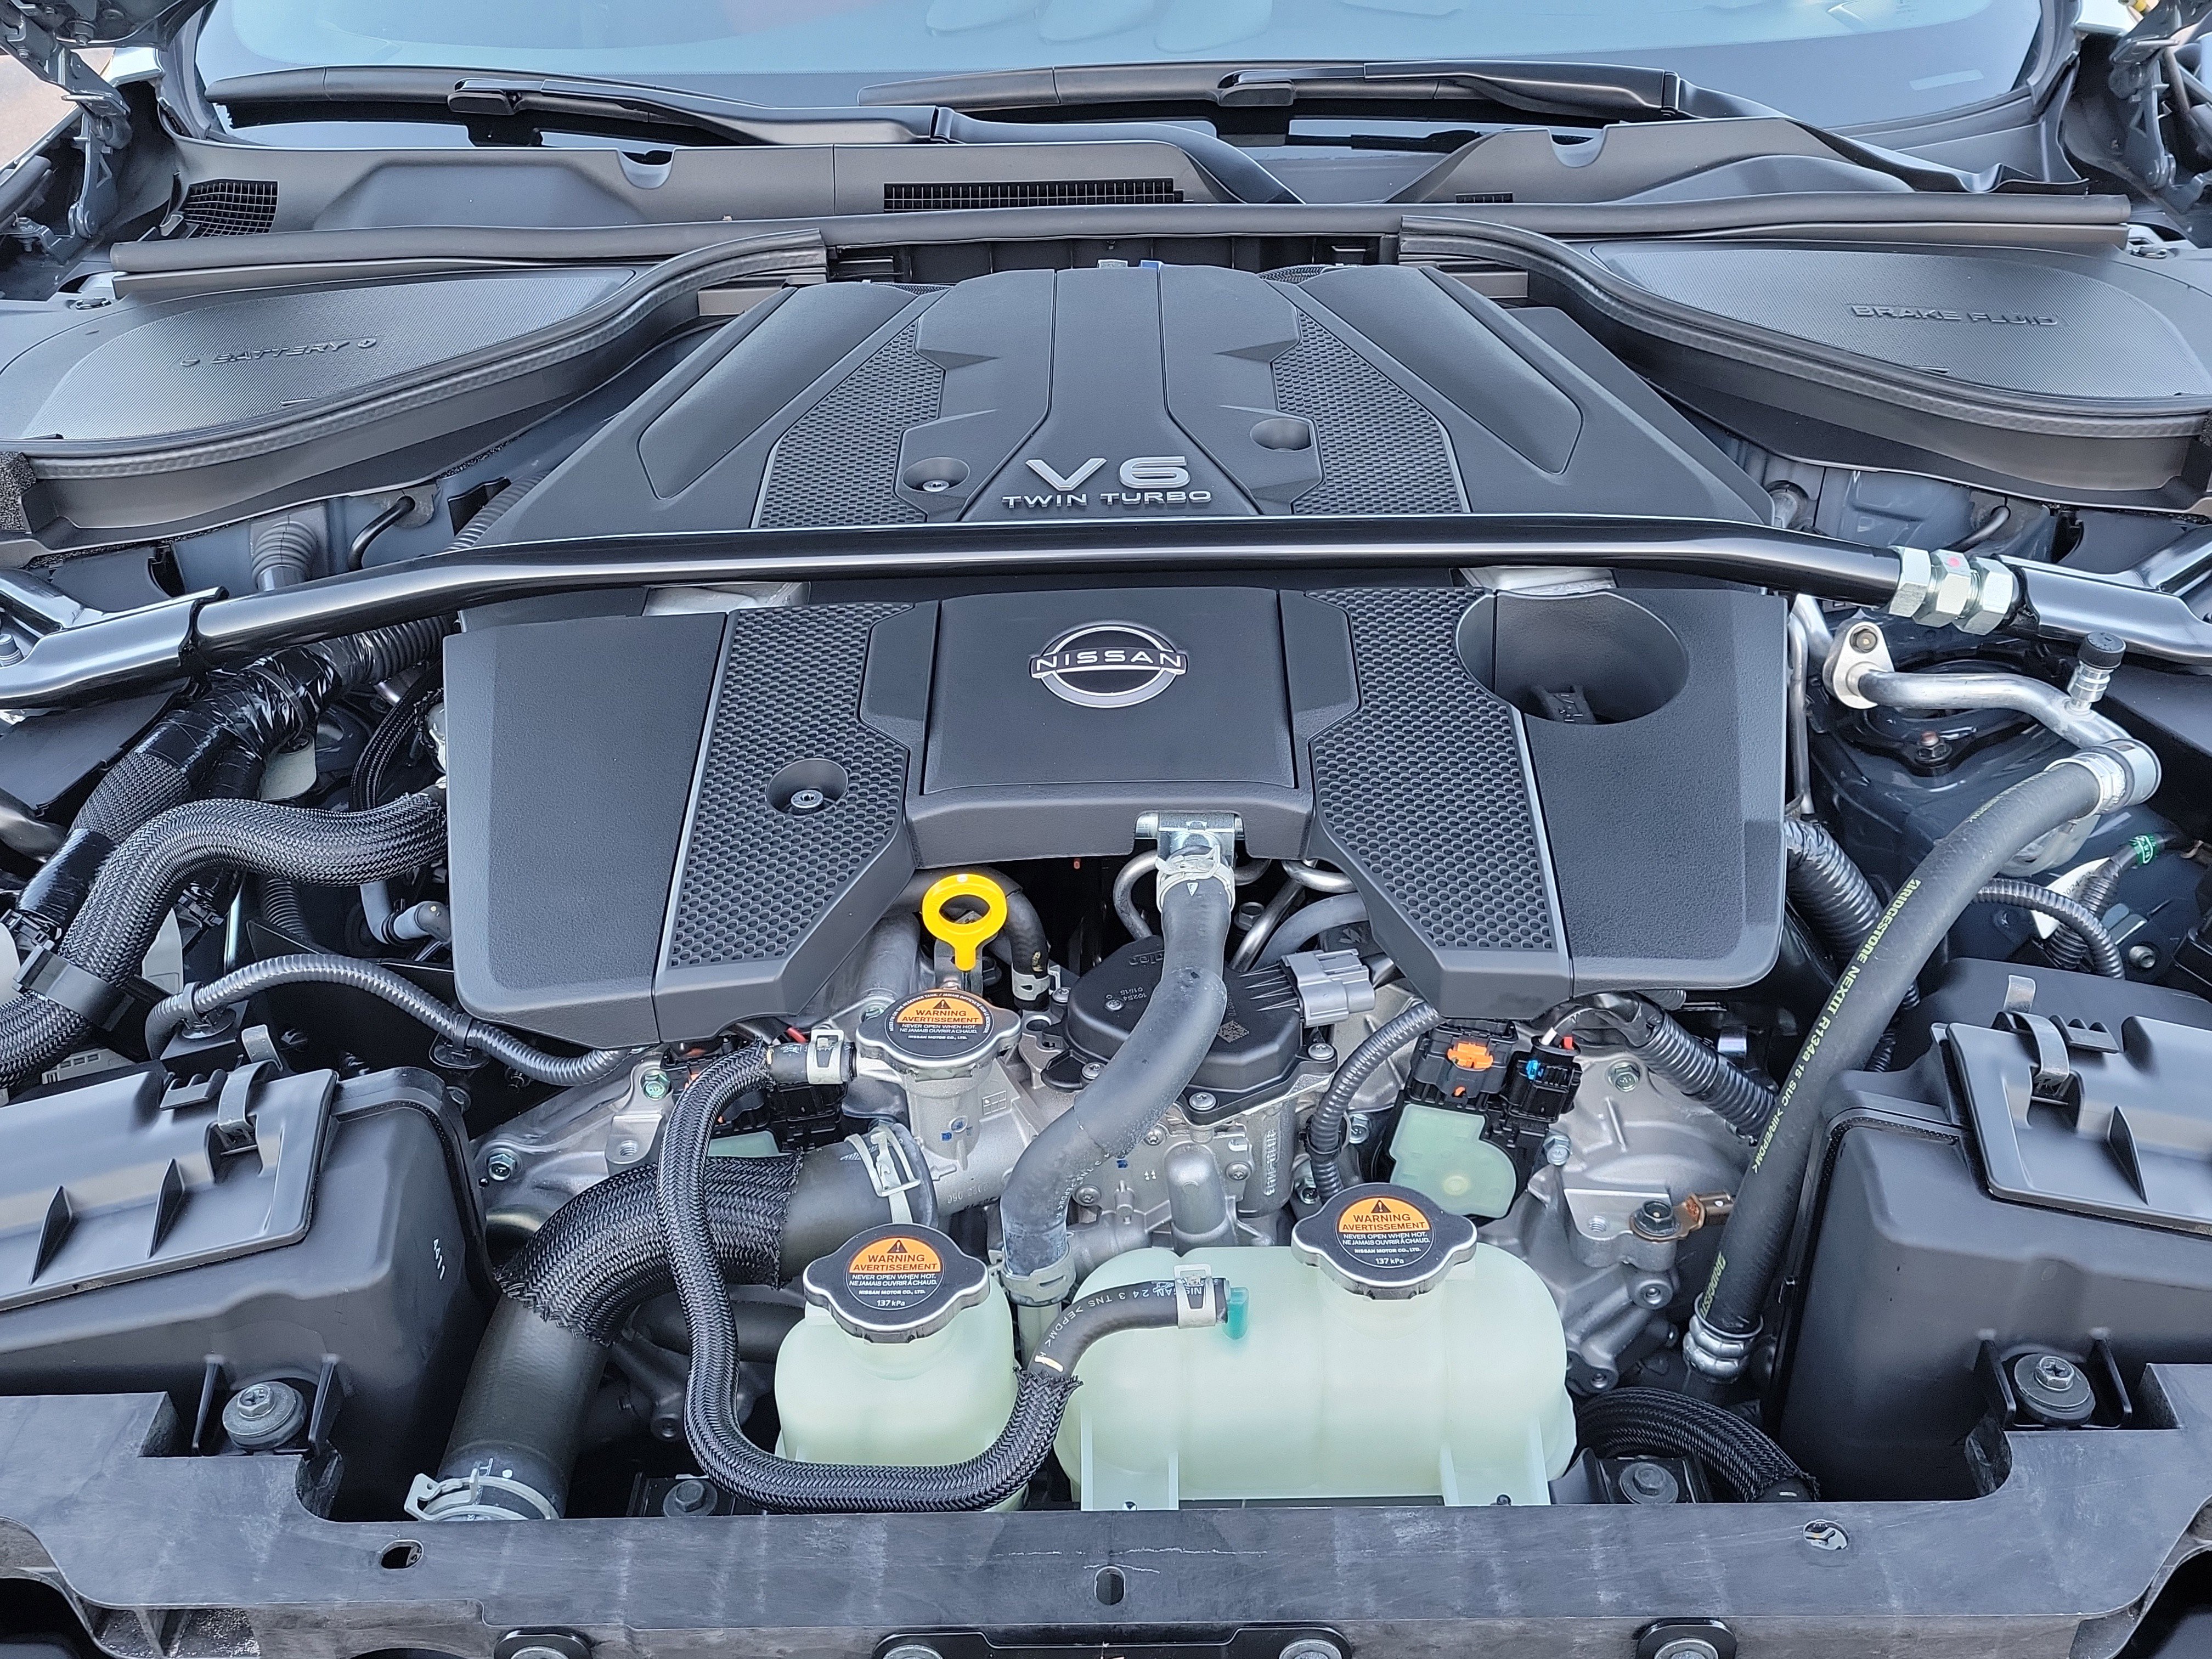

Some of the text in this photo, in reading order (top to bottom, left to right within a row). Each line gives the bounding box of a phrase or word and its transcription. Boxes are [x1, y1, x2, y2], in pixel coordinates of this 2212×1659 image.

[1851, 305, 2058, 326] BRAKE FLUID
[211, 339, 350, 364] BATTERY
[1025, 455, 1191, 491] V6
[1002, 490, 1212, 509] TWIN TURBO
[1036, 650, 1181, 672] NISSAN
[1857, 878, 1921, 964] BRIDGESTONE
[1802, 1014, 1832, 1063] R134a
[1781, 1078, 1798, 1107] SUC
[1342, 1222, 1425, 1231] AVERTISSEMENT
[1353, 1214, 1410, 1223] WARNING
[853, 1263, 938, 1271] AVERTISSEMENT
[868, 1254, 925, 1262] WARNING
[1087, 1295, 1113, 1307] TNS
